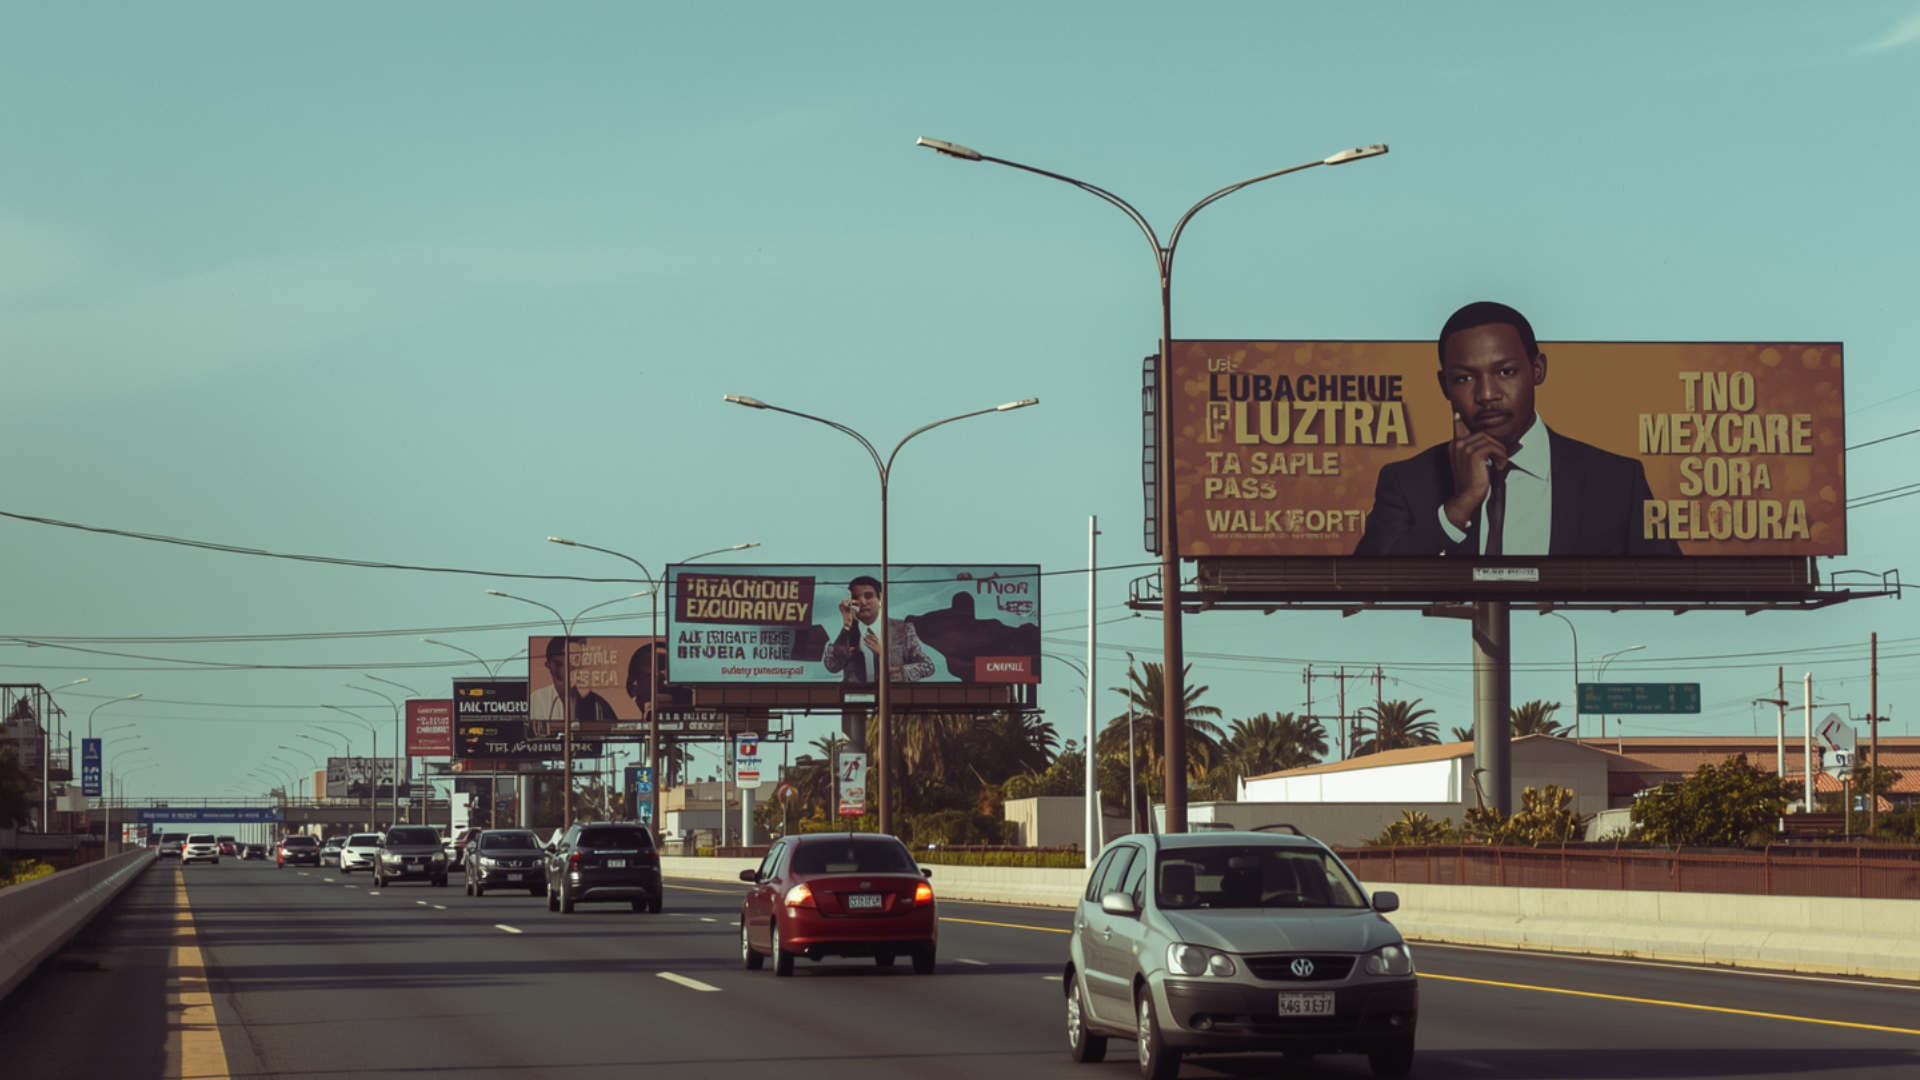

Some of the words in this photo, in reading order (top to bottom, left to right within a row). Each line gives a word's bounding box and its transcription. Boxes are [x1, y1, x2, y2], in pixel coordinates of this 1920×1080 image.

[1679, 371, 1755, 412] TNO
[1639, 413, 1813, 453] MEXCARE
[1205, 452, 1241, 475] TA
[1643, 499, 1810, 540] RELOURA
